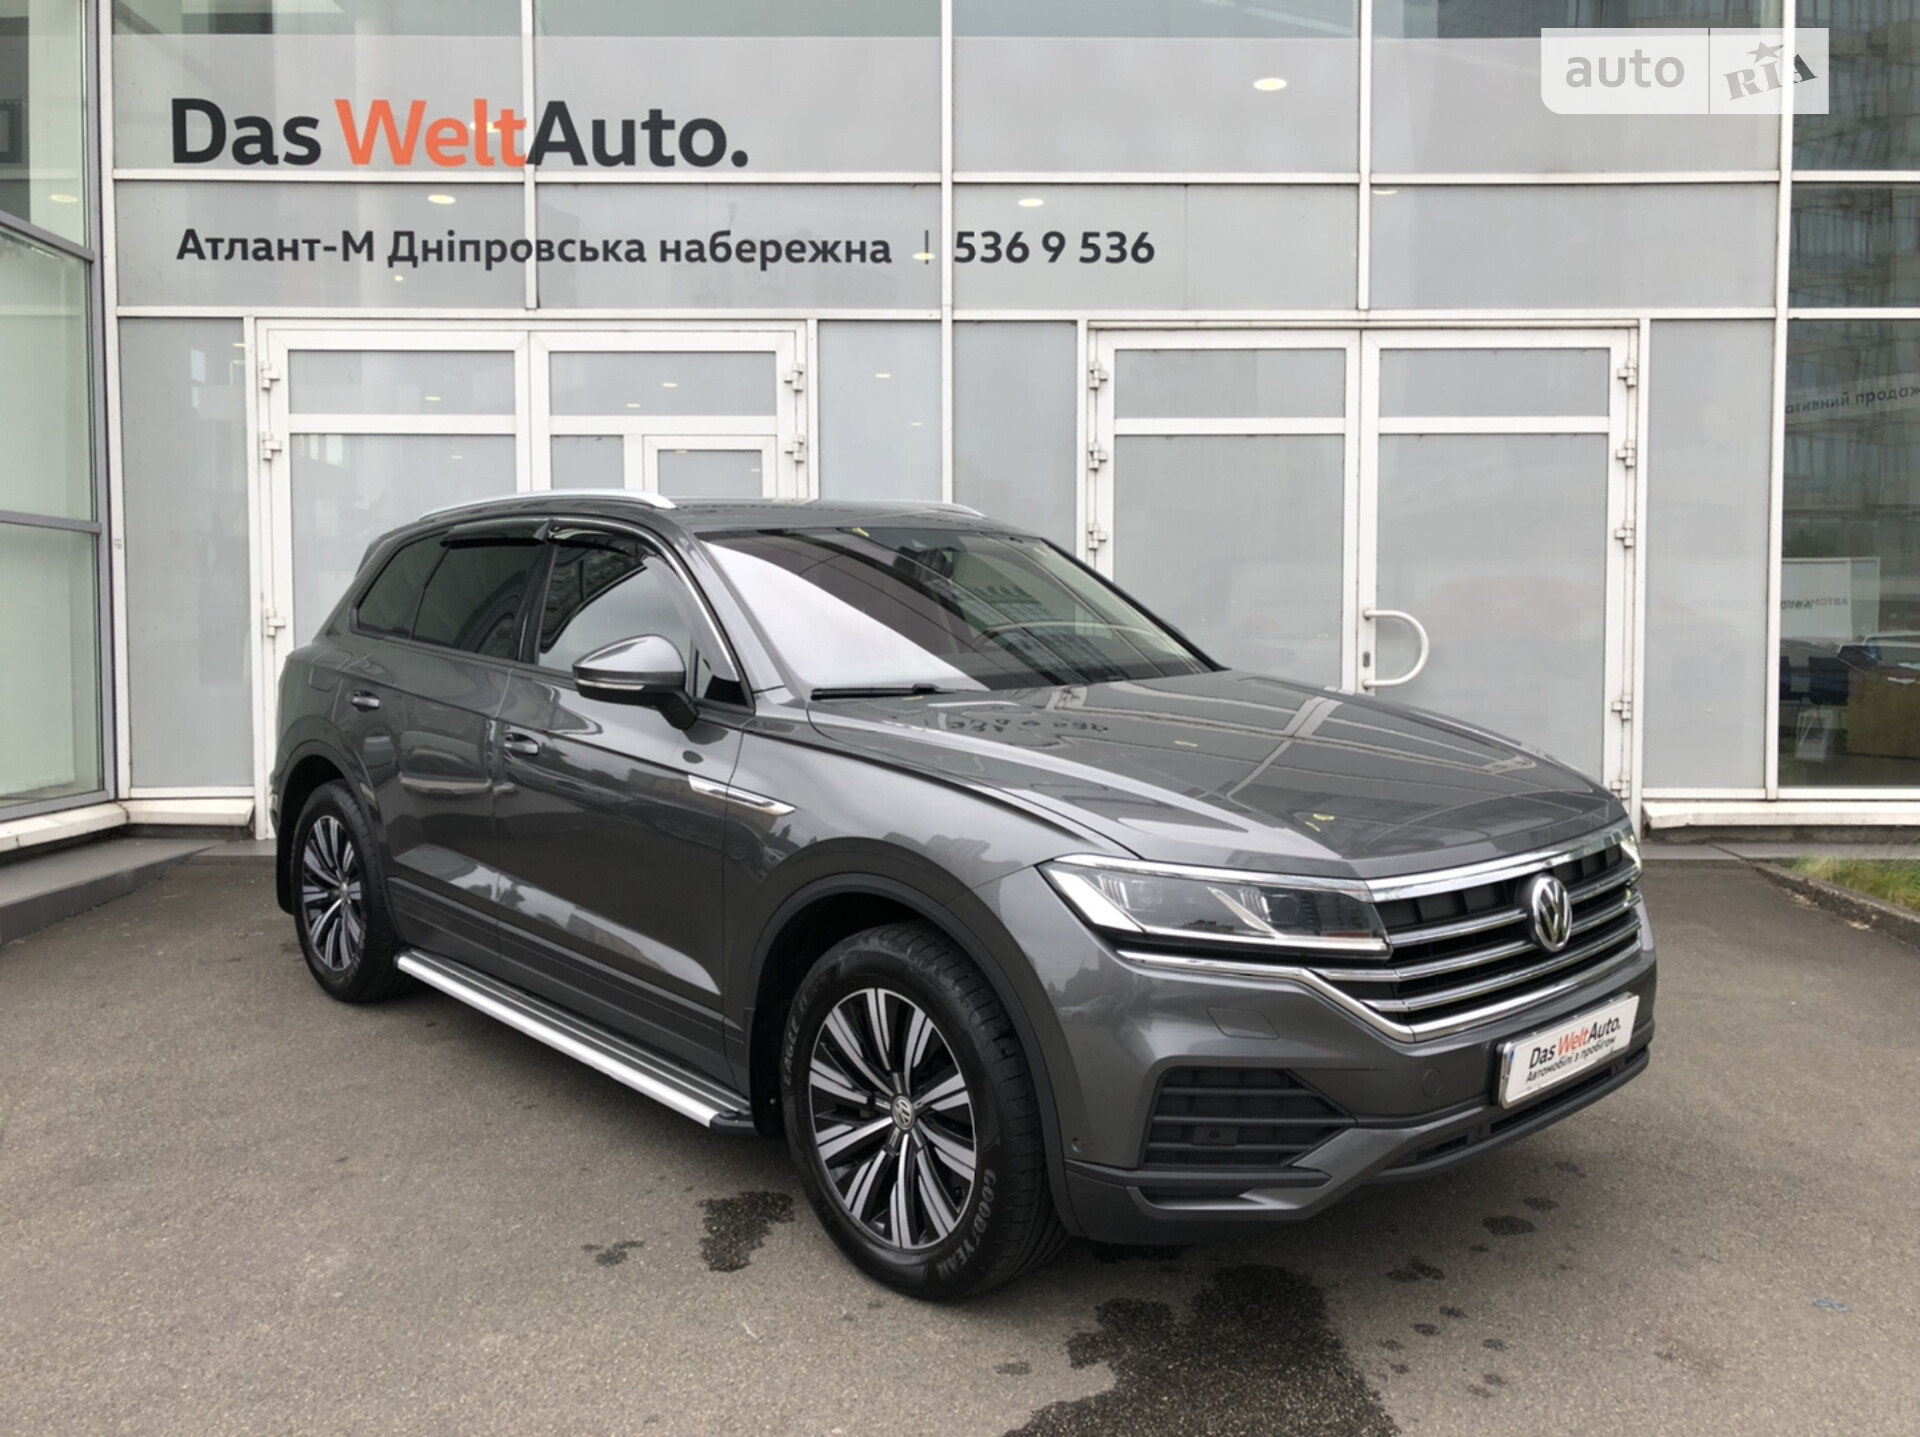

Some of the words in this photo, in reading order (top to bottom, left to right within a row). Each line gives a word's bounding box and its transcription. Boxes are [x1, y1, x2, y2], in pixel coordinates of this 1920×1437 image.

[172, 98, 322, 166] Das
[334, 98, 749, 168] WeltAuto.
[177, 229, 374, 262] Атлант-М
[388, 229, 647, 271] Дніпровська
[660, 229, 892, 272] набережна
[953, 231, 1030, 264] 536
[1042, 231, 1066, 263] 9
[1079, 231, 1155, 264] 536
[1529, 1045, 1556, 1069] Das
